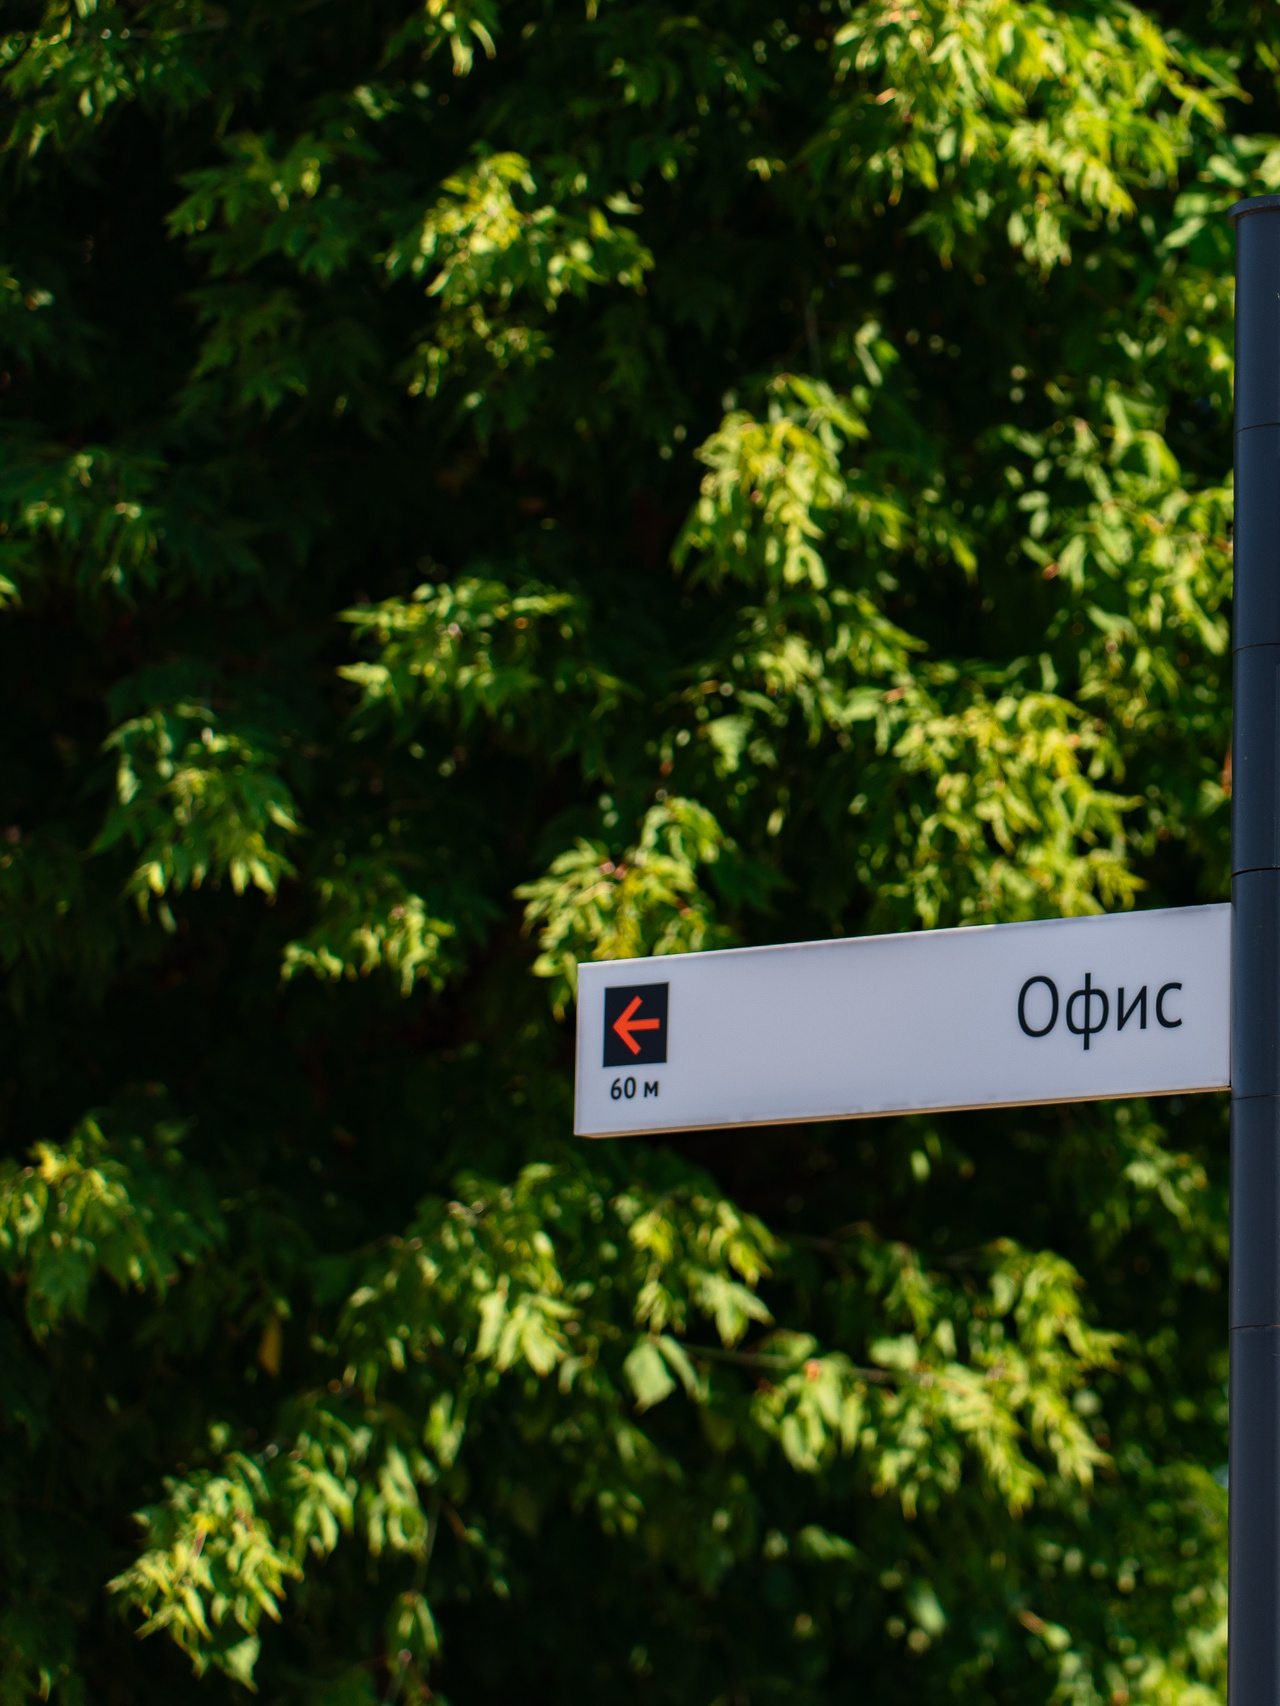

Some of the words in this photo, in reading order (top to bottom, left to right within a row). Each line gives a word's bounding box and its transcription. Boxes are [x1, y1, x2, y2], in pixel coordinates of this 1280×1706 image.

[1017, 972, 1183, 1051] Офис
[610, 1076, 637, 1101] 60
[643, 1080, 659, 1098] м
